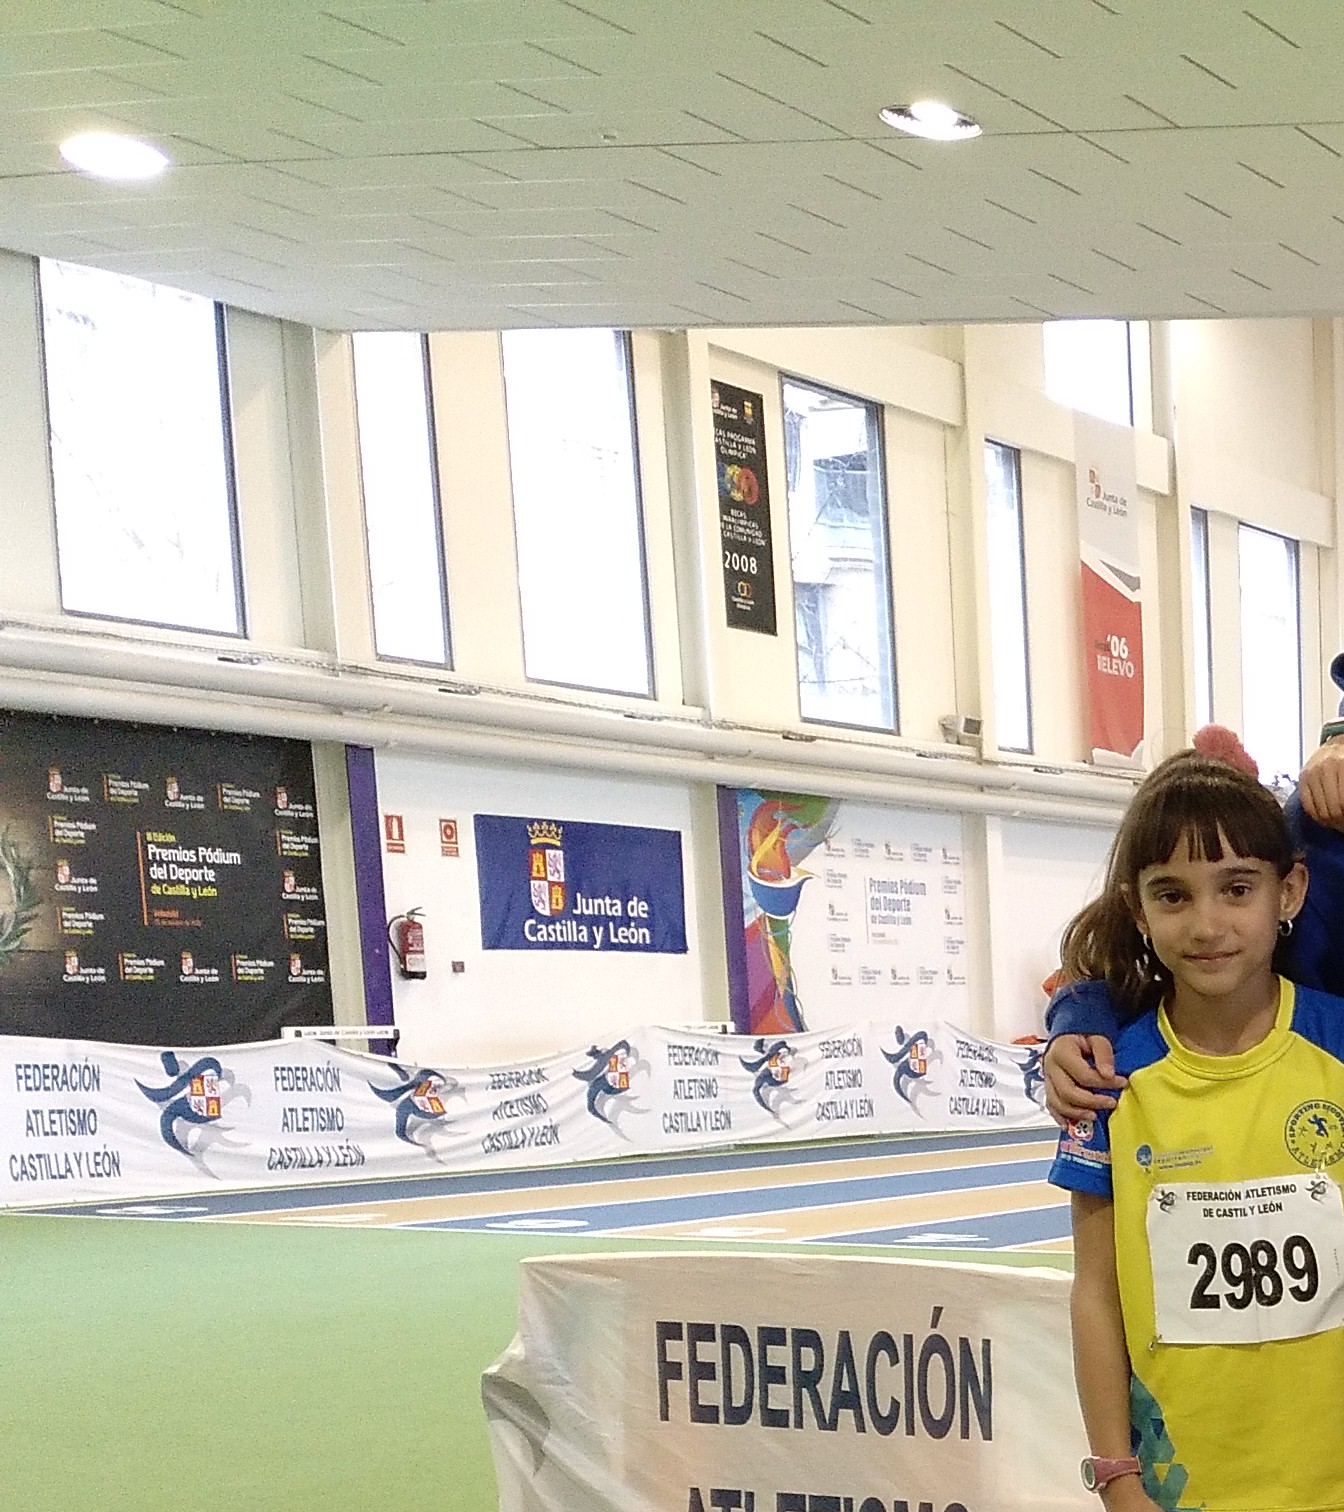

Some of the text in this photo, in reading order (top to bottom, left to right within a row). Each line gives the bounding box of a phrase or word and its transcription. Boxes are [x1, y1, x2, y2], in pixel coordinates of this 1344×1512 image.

[724, 551, 758, 575] 2008
[147, 844, 241, 865] Premios Pódium
[150, 863, 216, 885] del Deporte
[162, 884, 190, 896] Castilla
[572, 892, 648, 918] Junta de
[524, 919, 650, 949] Castilla y León
[15, 1056, 101, 1092] FEDERACIÓN
[273, 1060, 342, 1092] FEDERACIÓN
[825, 1069, 862, 1090] ATLETISMO
[673, 1078, 718, 1099] ATLETISMO
[282, 1107, 345, 1132] ATLETISMO
[662, 1111, 702, 1133] CASTILLA
[702, 1110, 708, 1131] Y
[816, 1099, 849, 1121] CASTILLA
[849, 1099, 854, 1119] Y
[1289, 1103, 1320, 1138] SPORTING
[26, 1108, 97, 1138] ATLETISMO
[9, 1143, 121, 1181] CASTILLA Y LEÓN
[267, 1146, 323, 1170] CASTILLA
[322, 1146, 332, 1167] Y
[1186, 1184, 1297, 1201] FEDERACIÓN ATLETISMO
[1203, 1207, 1213, 1218] DE
[1249, 1205, 1255, 1215] Y
[1257, 1201, 1283, 1214] LEÓN
[1187, 1234, 1320, 1311] 2989
[655, 1306, 993, 1442] FEDERACIÓN
